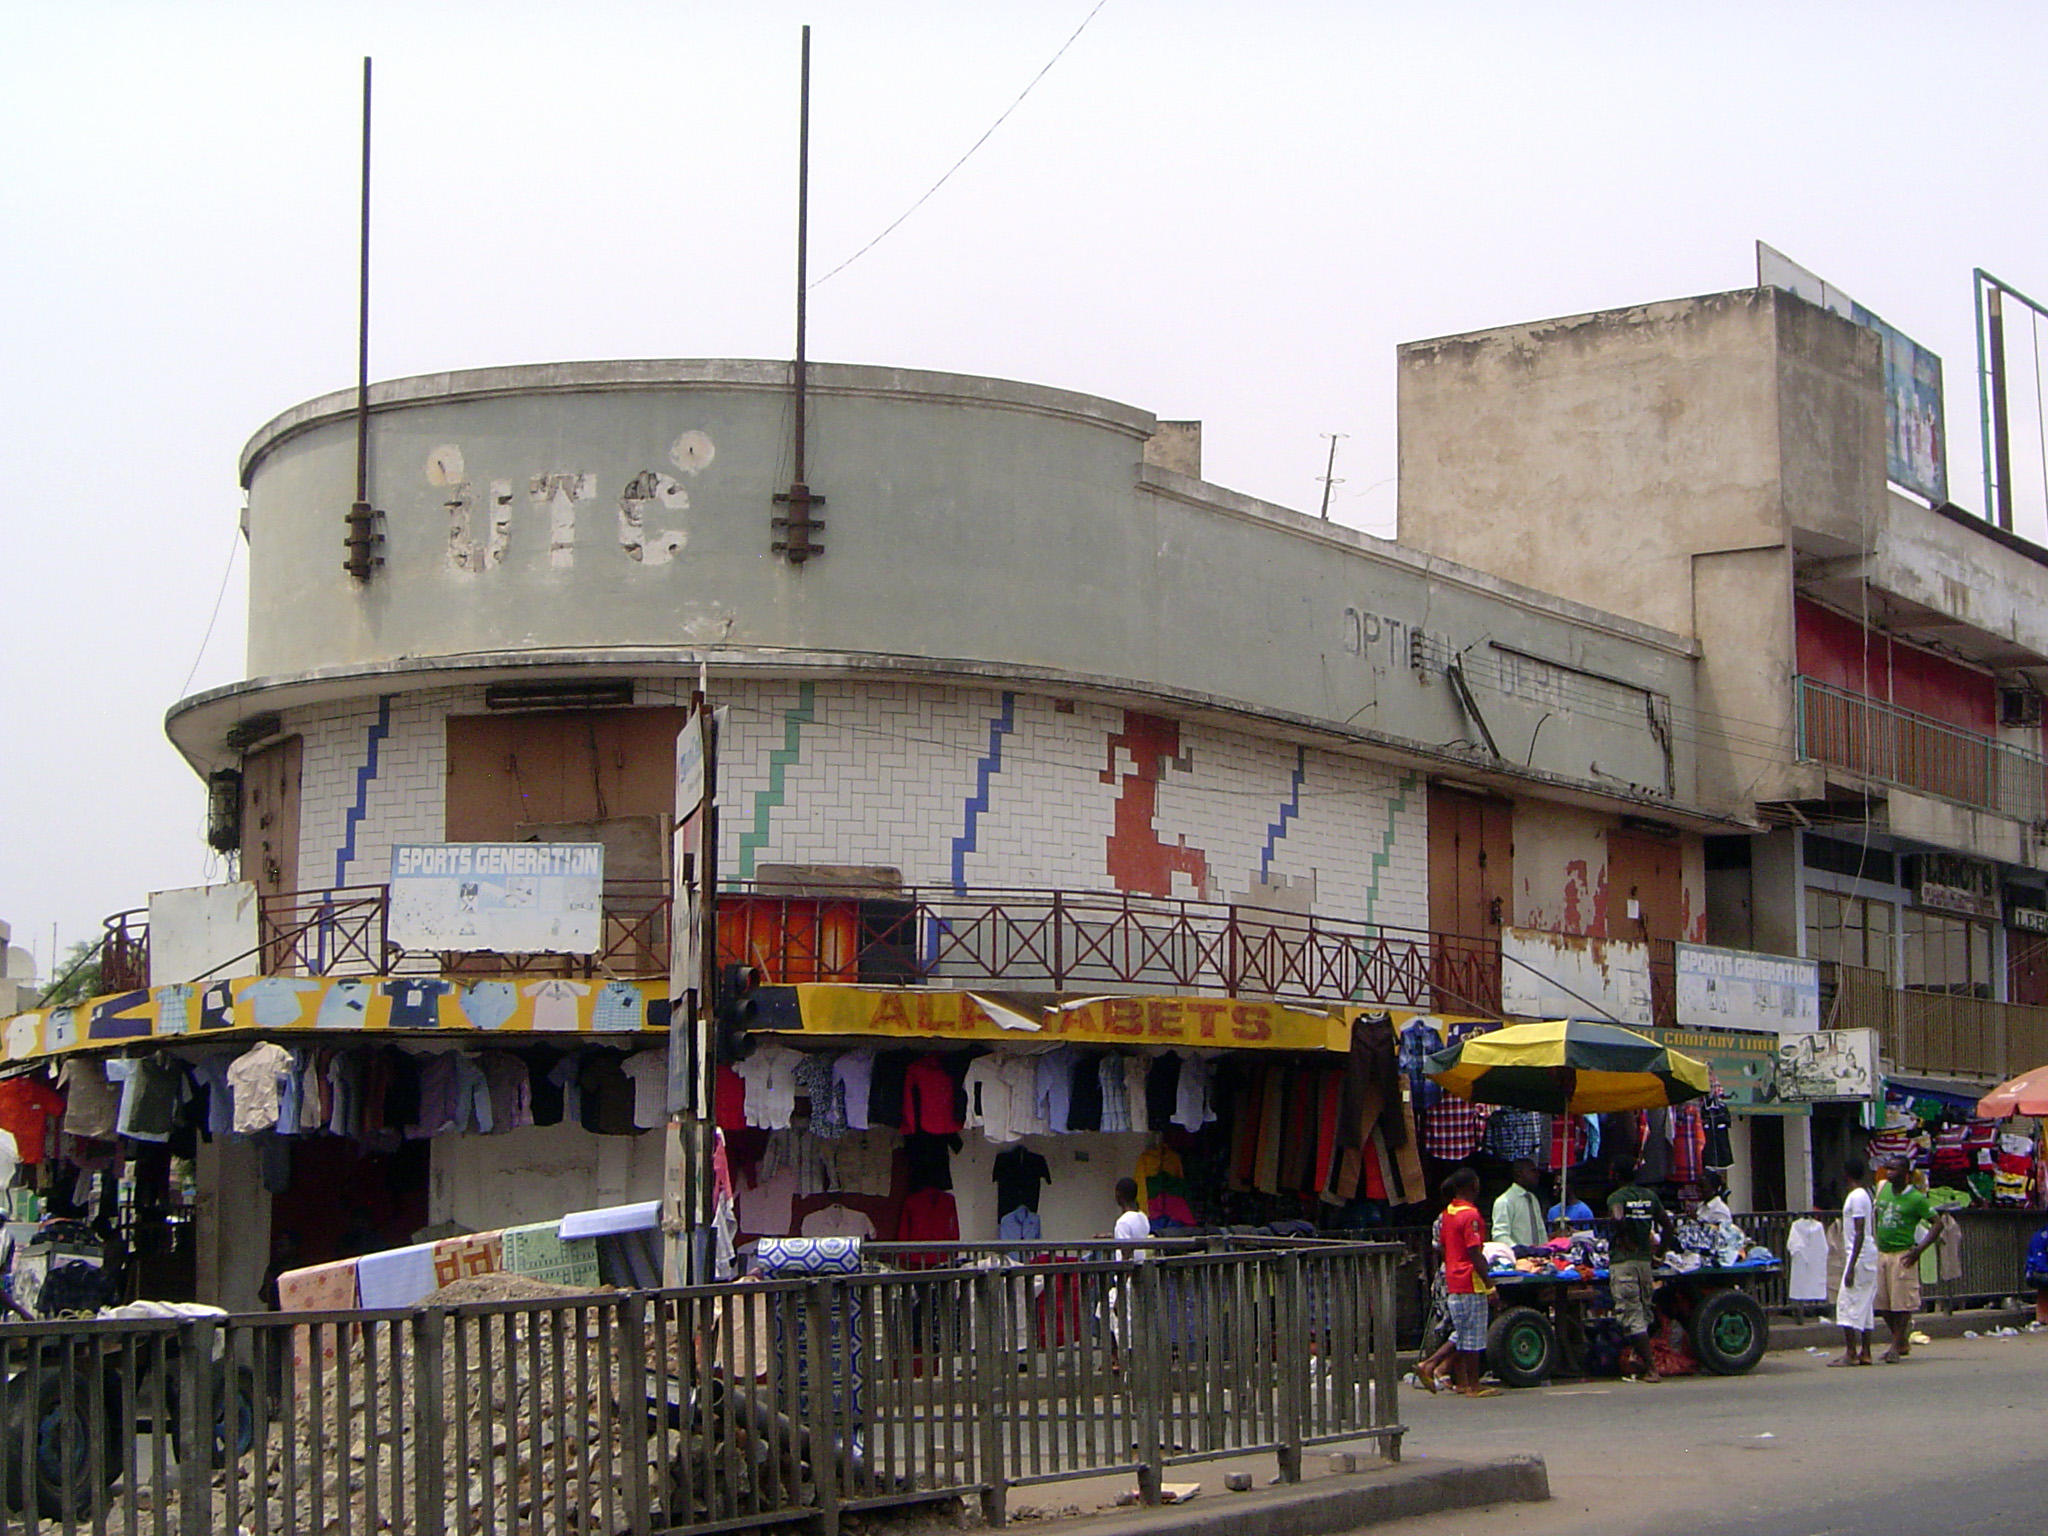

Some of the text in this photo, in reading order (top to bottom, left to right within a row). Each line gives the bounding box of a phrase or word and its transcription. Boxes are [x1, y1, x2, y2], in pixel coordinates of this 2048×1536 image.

[447, 470, 690, 574] UTC
[398, 847, 600, 874] SPORTS GENERATION
[1679, 949, 1815, 986] SPORTS GENERATION
[868, 990, 1273, 1042] ALPABETS
[1663, 1031, 1735, 1049] COMPANY
[1739, 1037, 1780, 1052] LIMI
